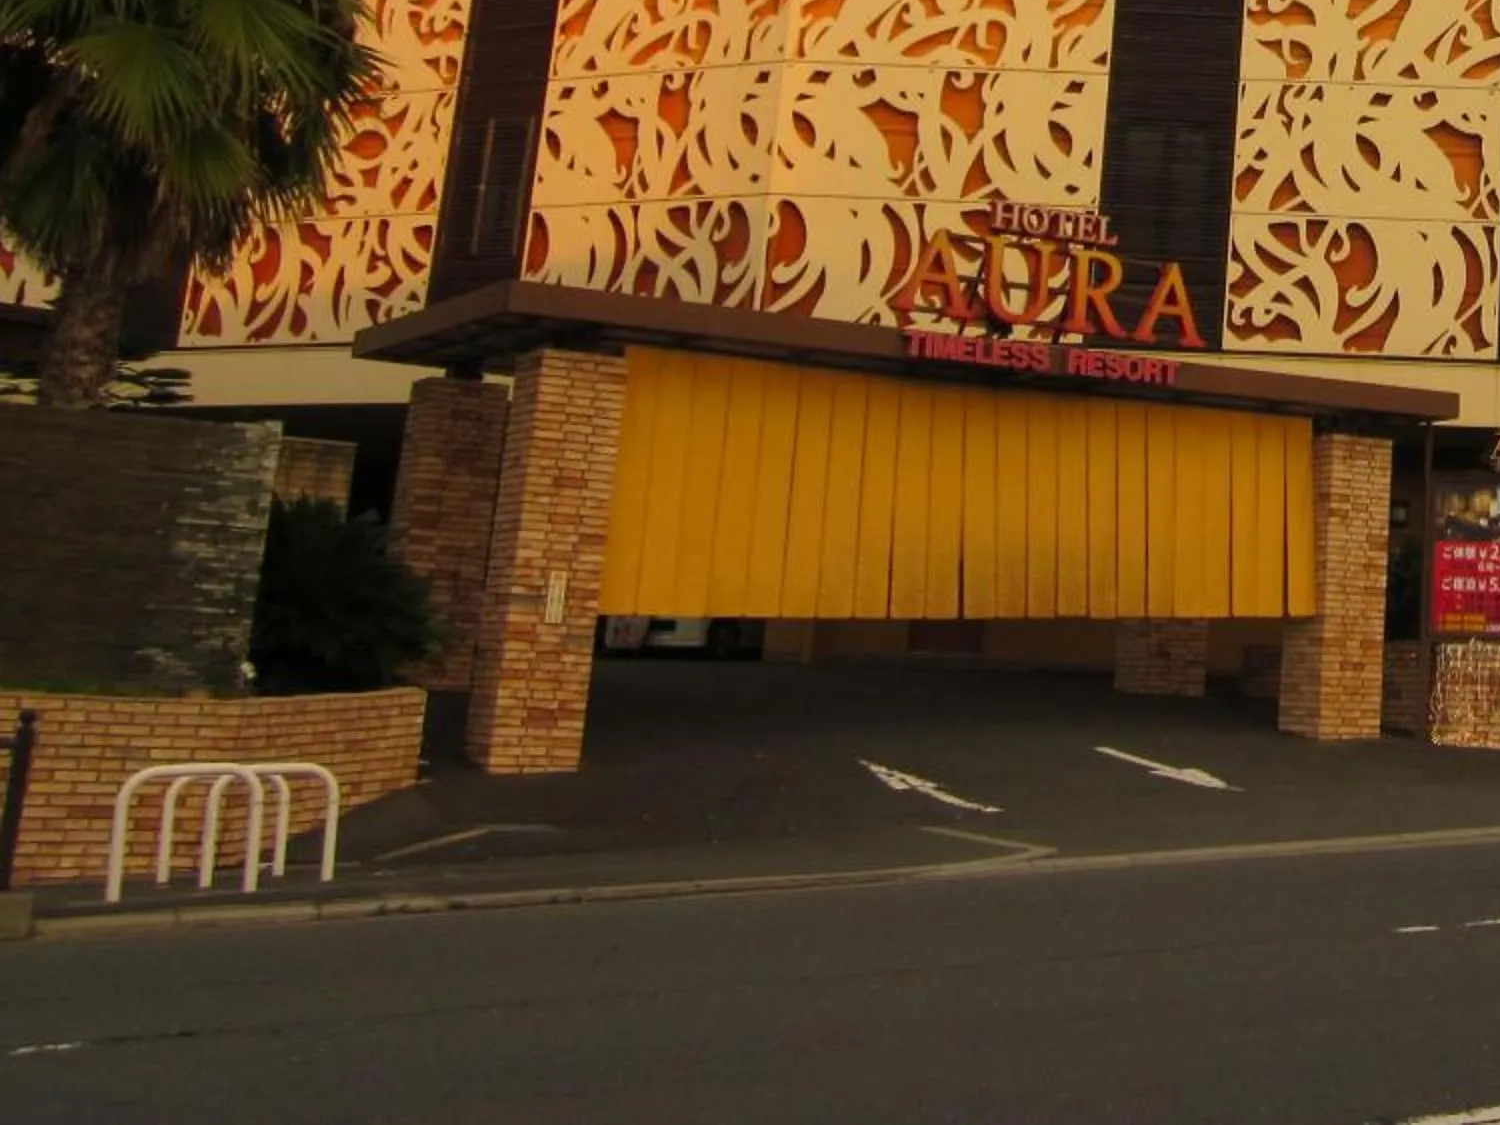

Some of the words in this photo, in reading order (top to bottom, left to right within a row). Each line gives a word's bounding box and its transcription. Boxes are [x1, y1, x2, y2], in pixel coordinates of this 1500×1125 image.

[991, 200, 1119, 246] HOTEL
[889, 229, 1207, 349] AURA
[904, 331, 1051, 371] TIMELESS
[1067, 348, 1182, 386] RESORT
